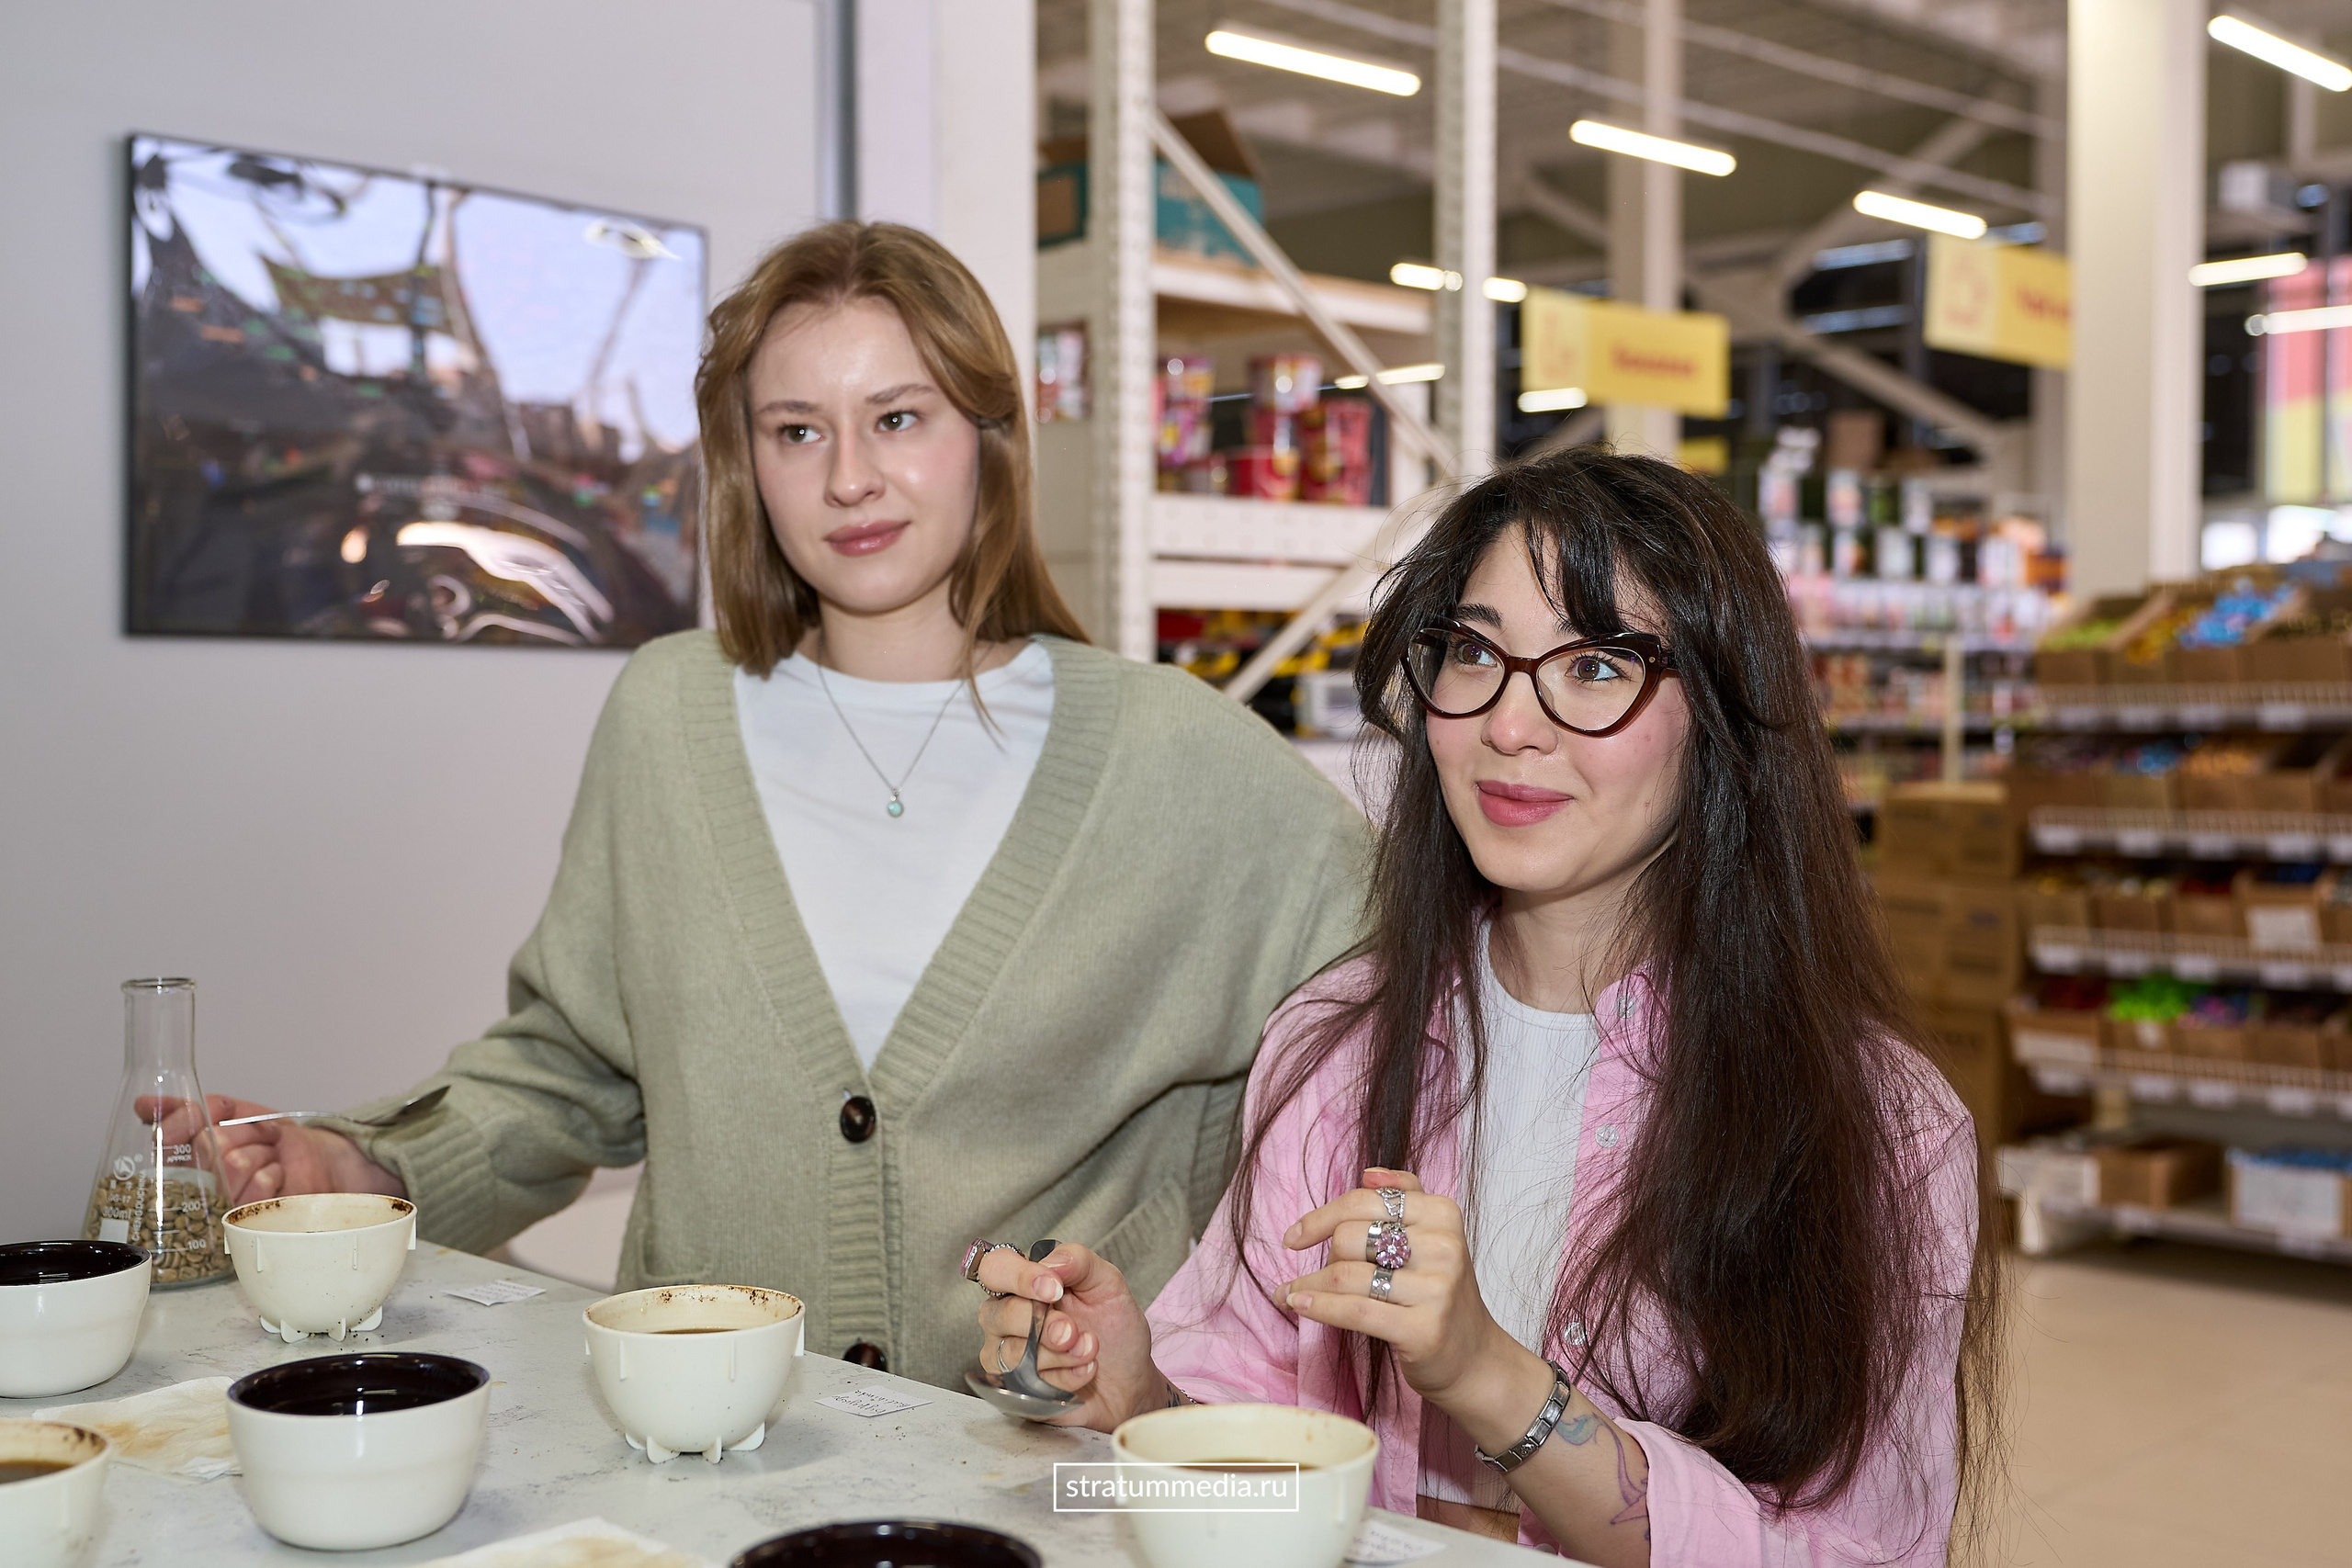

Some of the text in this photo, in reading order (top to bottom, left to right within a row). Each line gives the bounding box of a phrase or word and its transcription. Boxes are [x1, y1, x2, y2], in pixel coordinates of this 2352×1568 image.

[173, 1144, 192, 1155] 300
[181, 1201, 201, 1213] 200
[187, 1238, 207, 1250] 100
